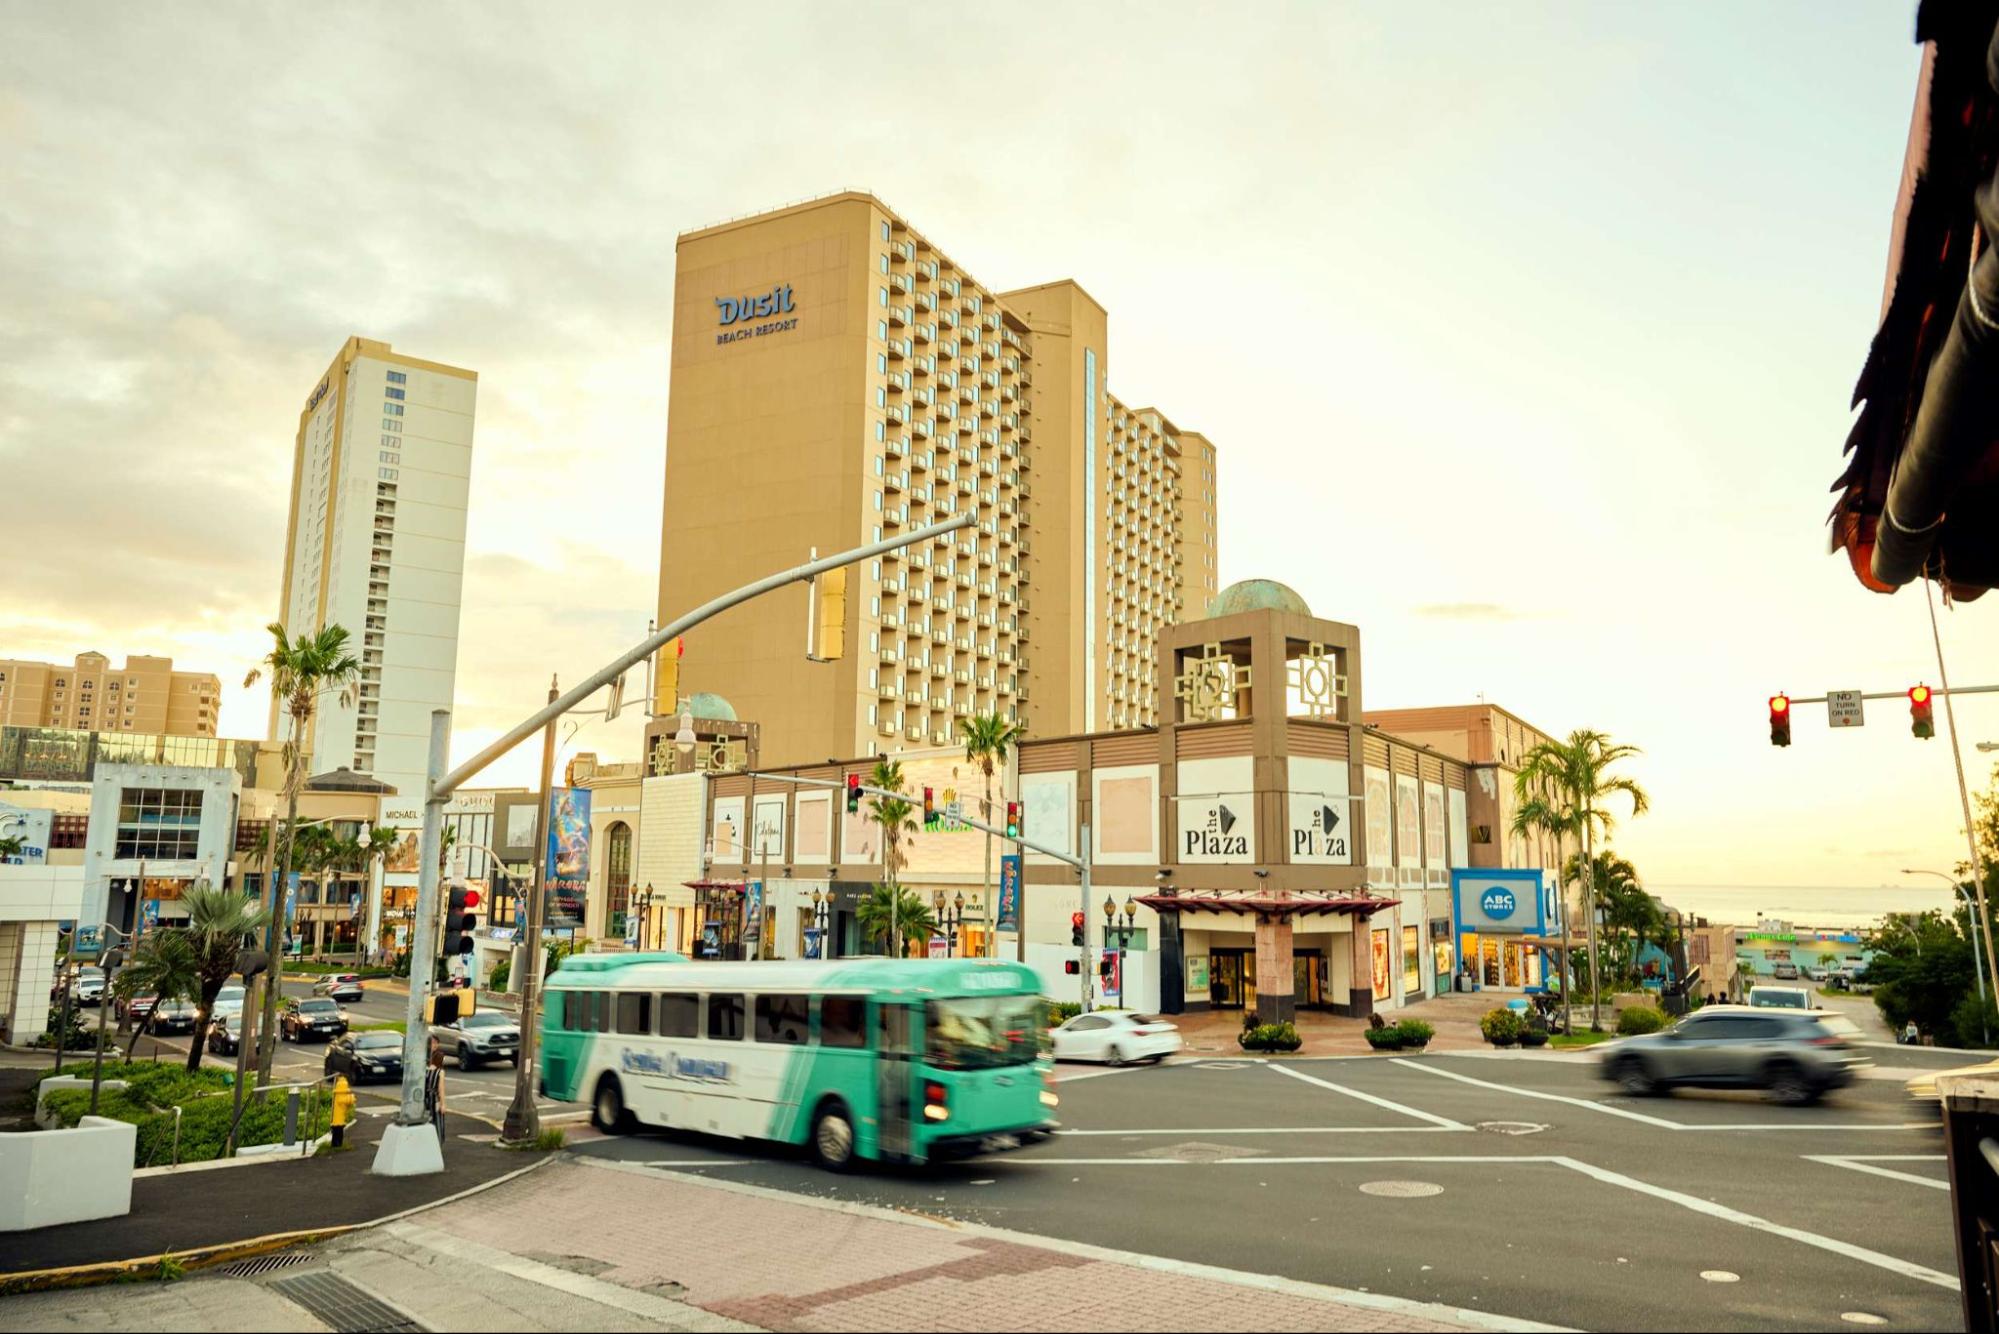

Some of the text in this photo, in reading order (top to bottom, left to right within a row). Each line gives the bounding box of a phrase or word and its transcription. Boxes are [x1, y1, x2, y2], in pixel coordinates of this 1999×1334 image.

[715, 283, 796, 325] Dusit
[717, 318, 798, 345] BEACH RESORT
[1837, 693, 1852, 701] NO
[1207, 809, 1217, 834] the
[1185, 830, 1248, 855] Plaza
[1484, 895, 1513, 905] ABC
